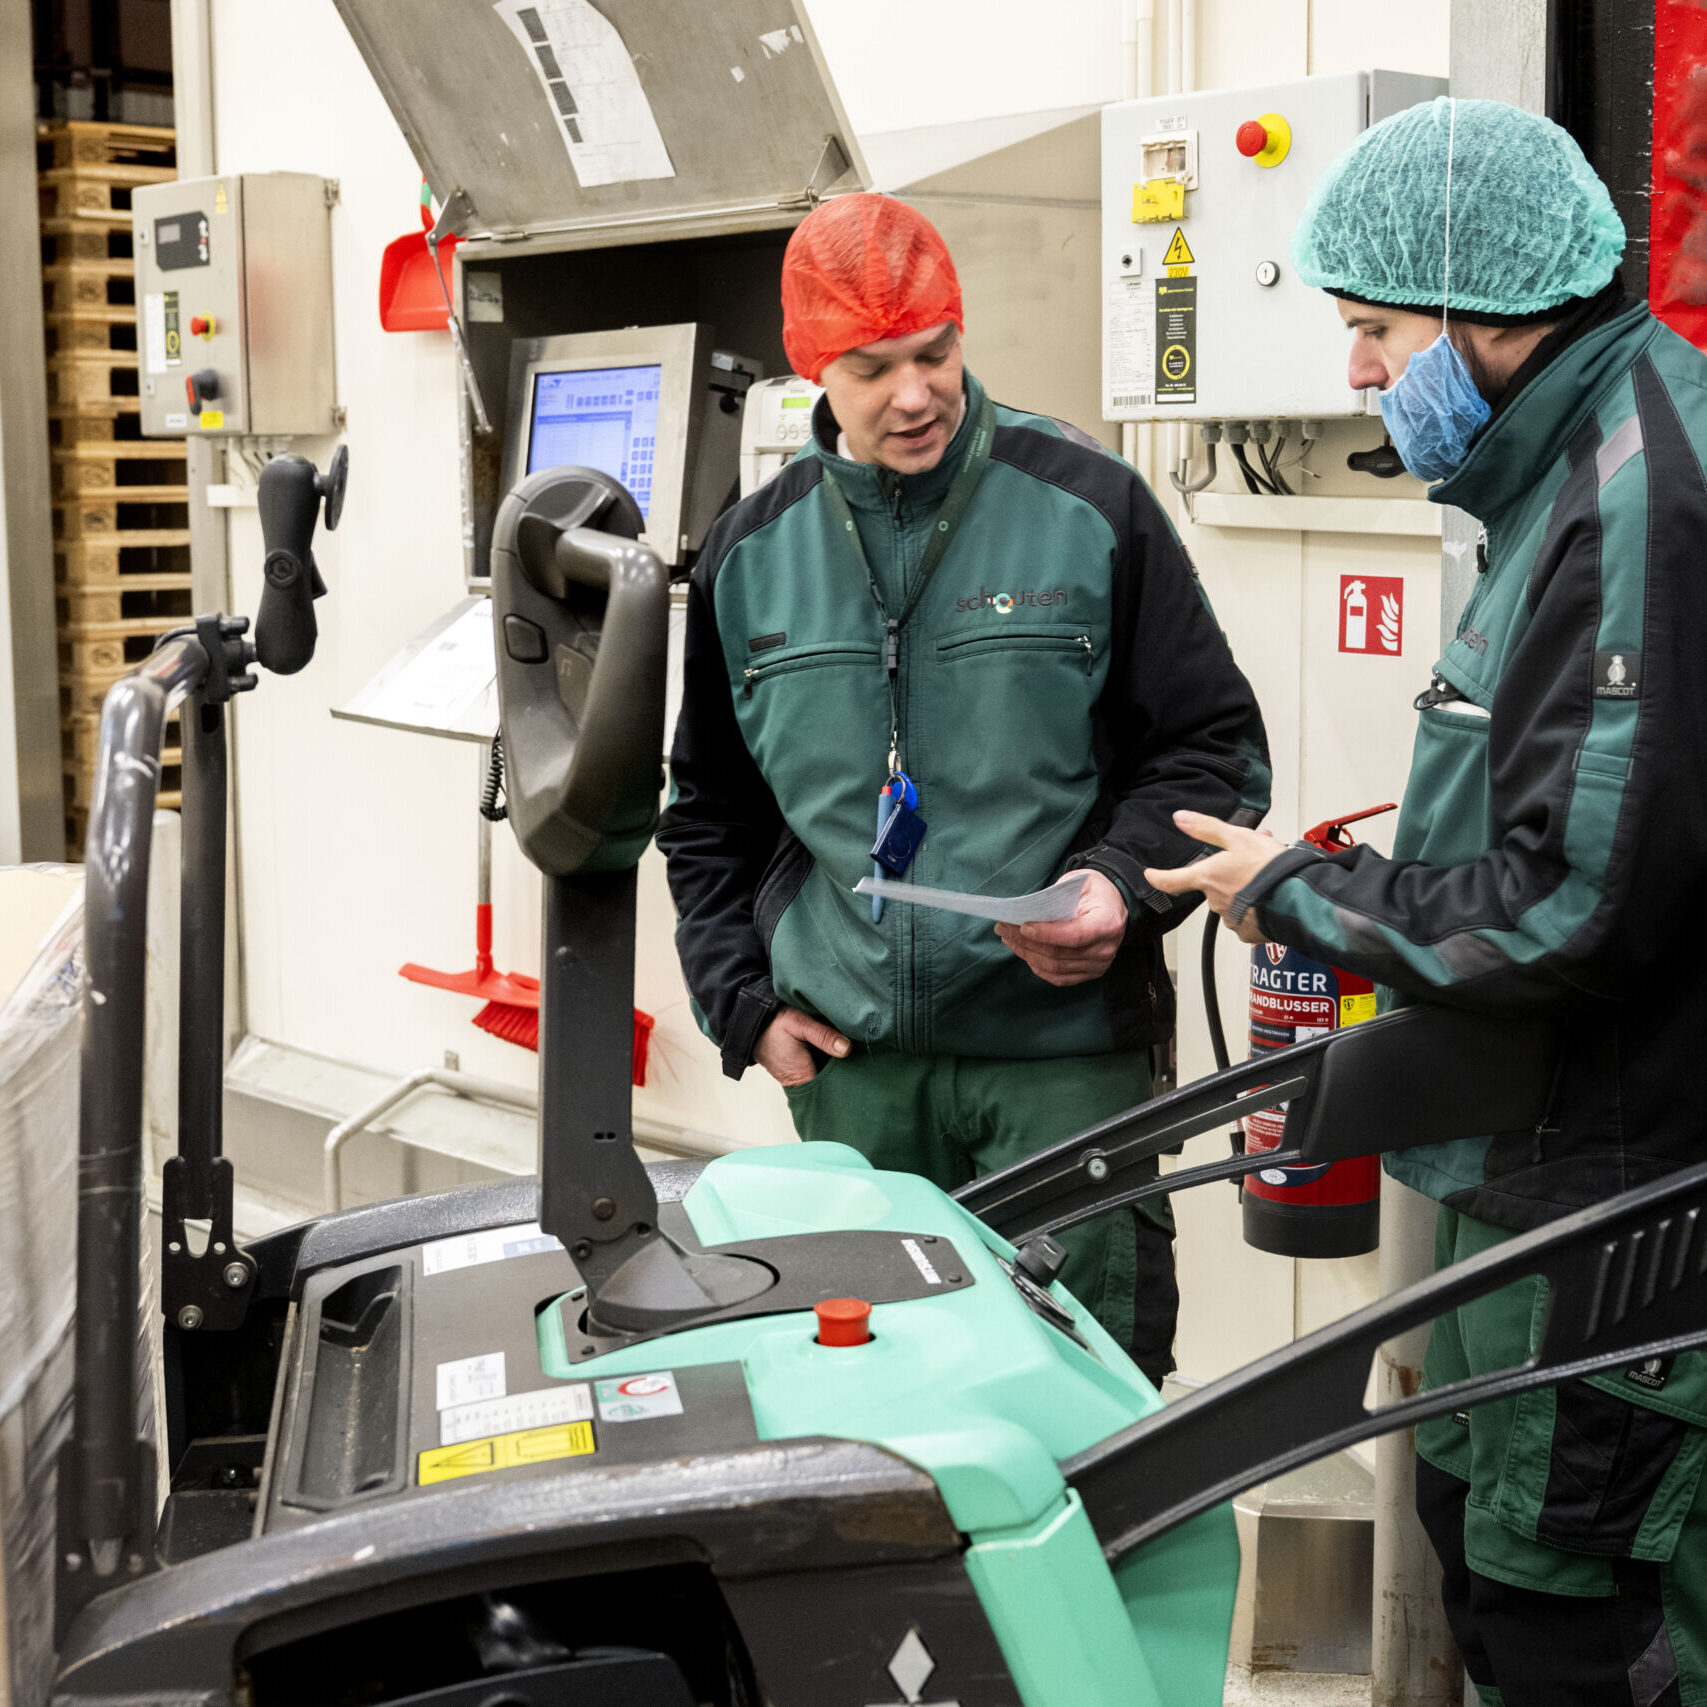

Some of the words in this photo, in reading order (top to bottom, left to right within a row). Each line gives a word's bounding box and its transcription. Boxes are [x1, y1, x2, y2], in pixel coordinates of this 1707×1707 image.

[956, 585, 1067, 613] schouten
[1596, 686, 1636, 696] MASCOT
[1251, 964, 1328, 992] RAGTER
[1250, 993, 1330, 1013] RANDBLUSSER
[1629, 1371, 1662, 1386] MASCOT
